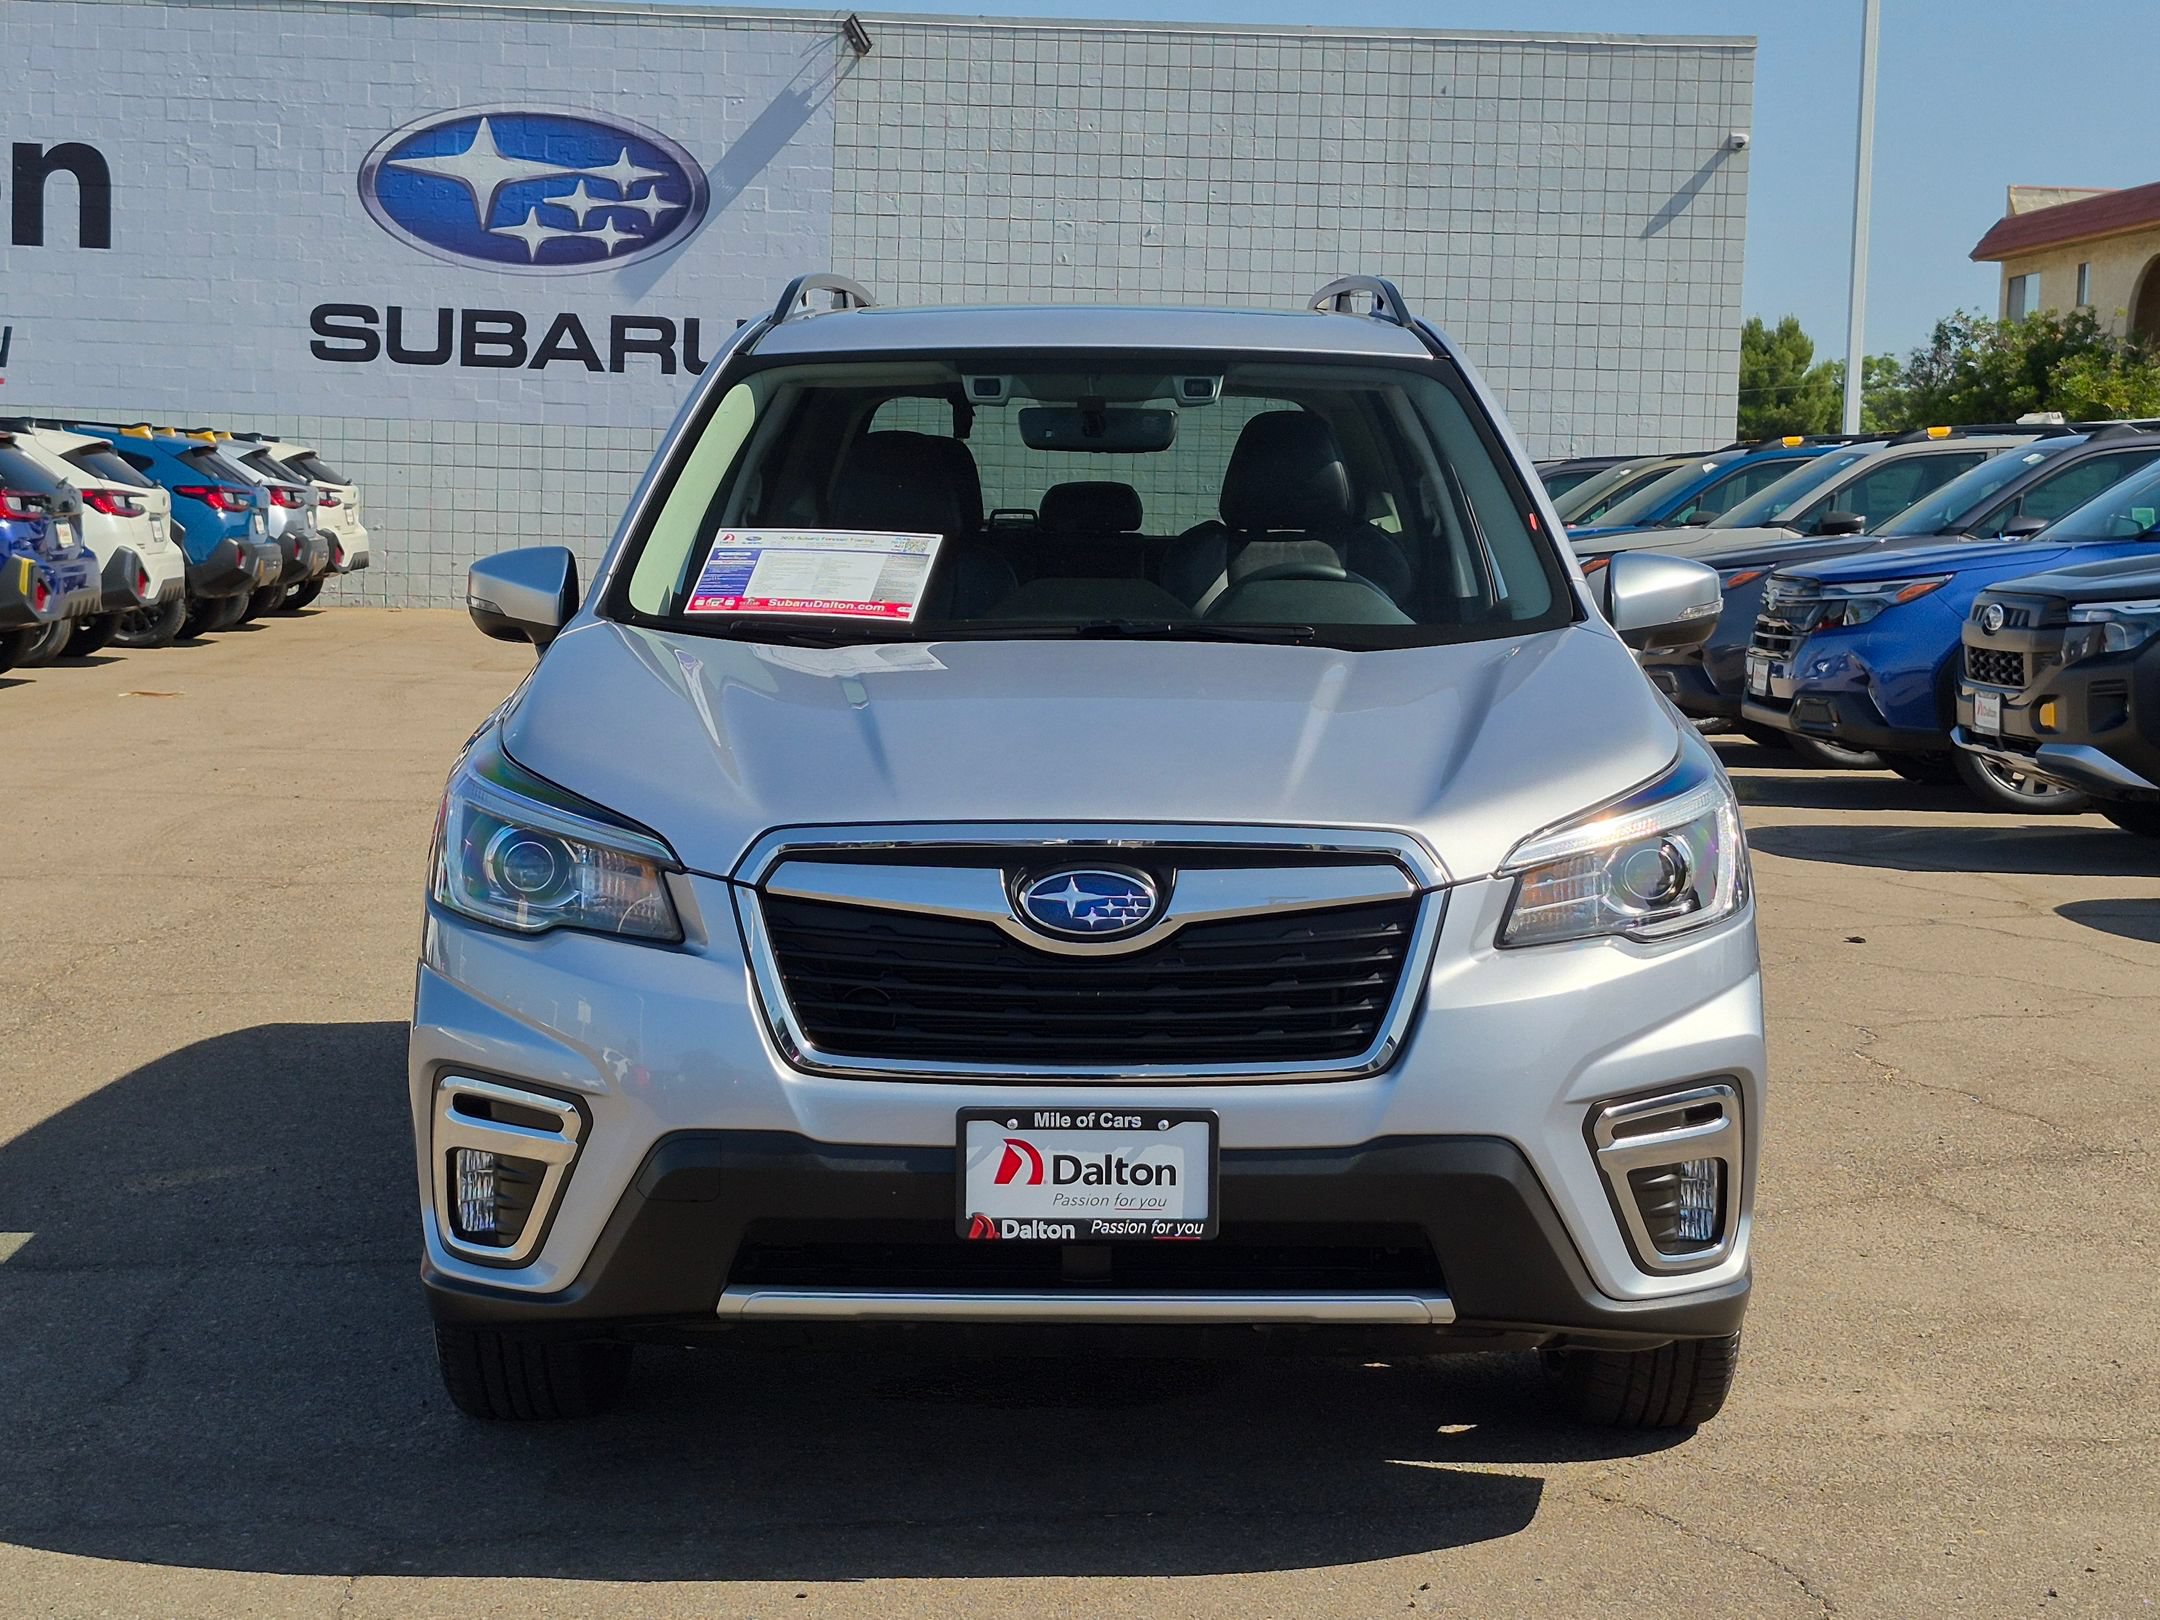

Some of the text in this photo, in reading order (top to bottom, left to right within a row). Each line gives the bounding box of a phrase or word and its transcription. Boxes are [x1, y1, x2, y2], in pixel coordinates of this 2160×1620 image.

[0, 142, 112, 249] n
[767, 598, 885, 613] SubaruDalton.com
[1033, 1112, 1142, 1128] Mile of Cars
[1052, 1154, 1177, 1186] Dalton
[1052, 1192, 1167, 1209] Passion for you
[1001, 1219, 1076, 1239] Dalton
[1090, 1219, 1204, 1237] Passion for you
